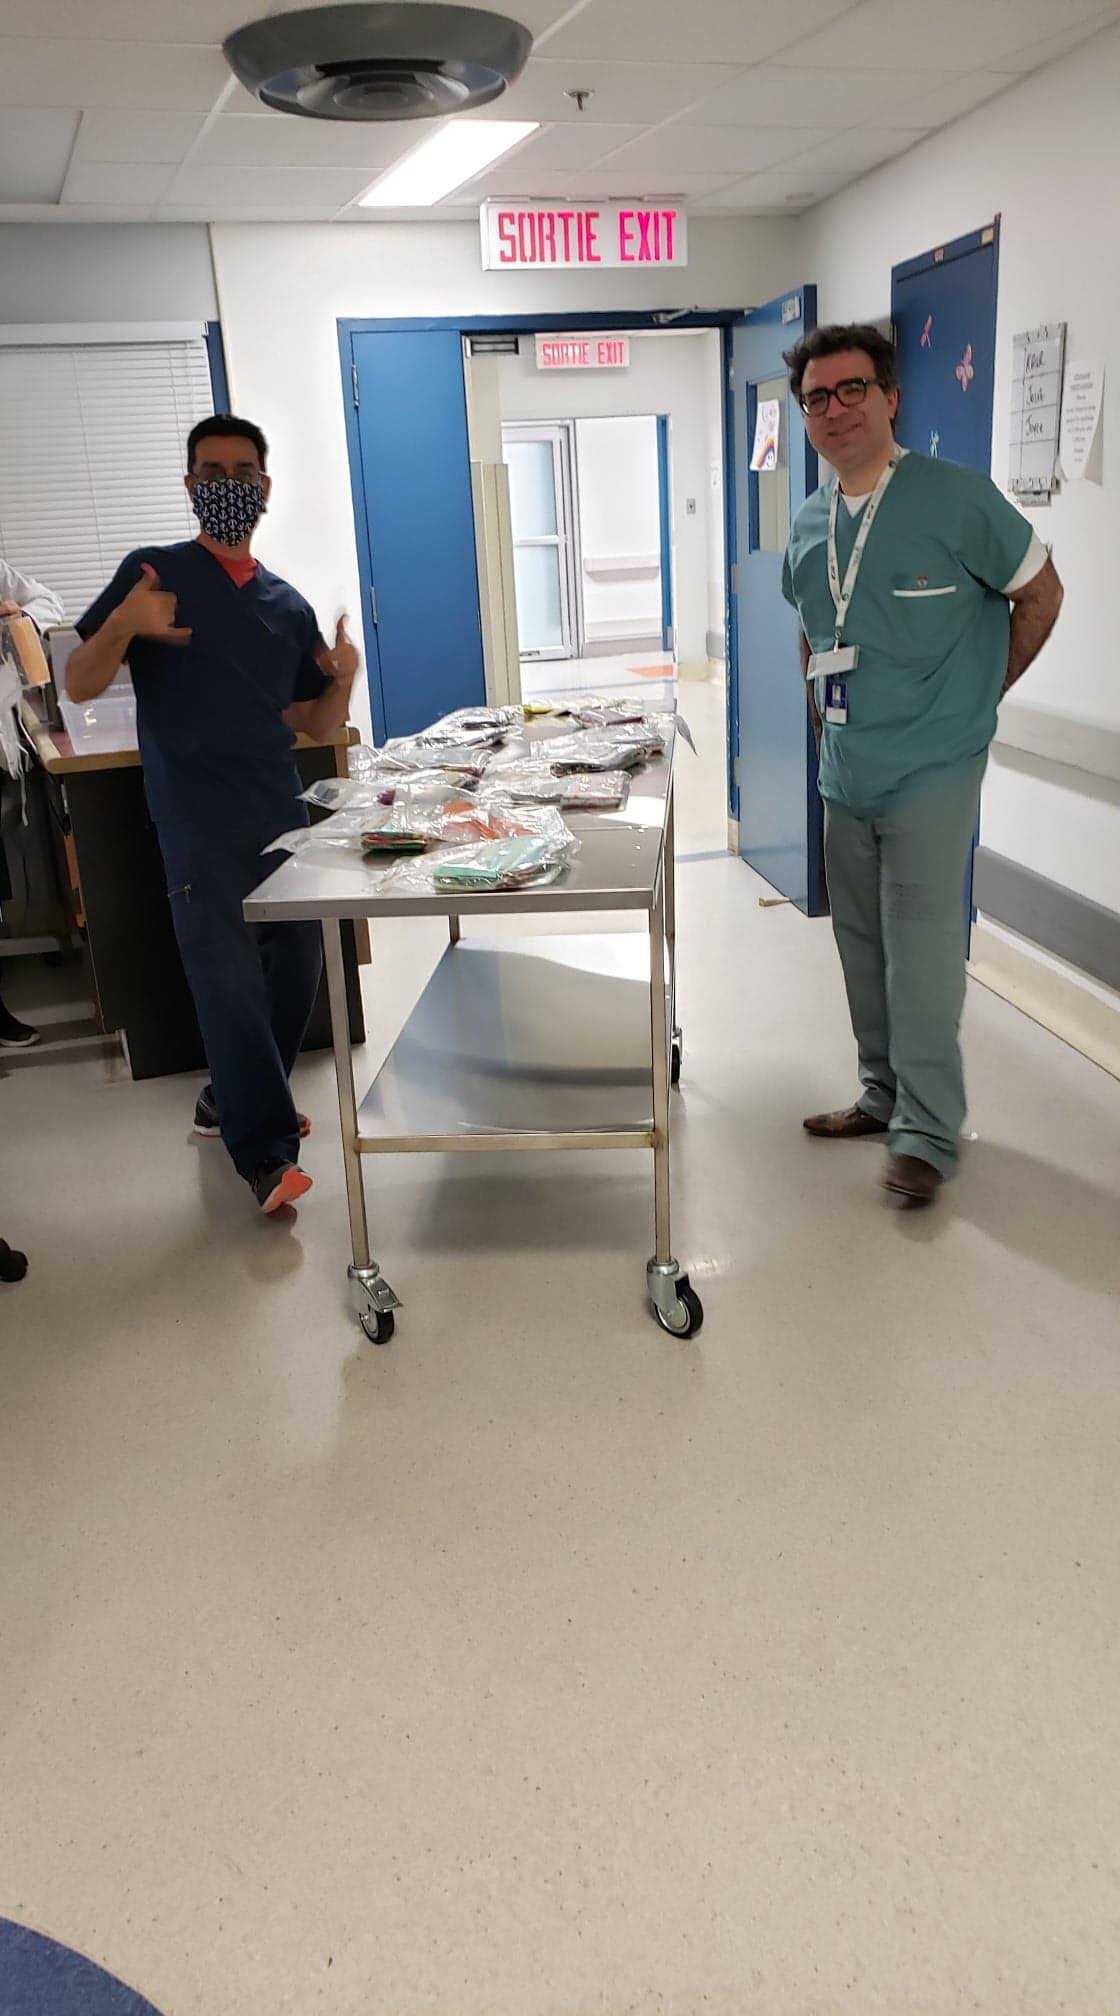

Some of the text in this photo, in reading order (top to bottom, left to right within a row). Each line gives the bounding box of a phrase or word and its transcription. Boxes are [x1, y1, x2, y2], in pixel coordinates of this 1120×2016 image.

[498, 210, 677, 262] SORTIE EXIT
[542, 341, 625, 366] SORTIE EXIT
